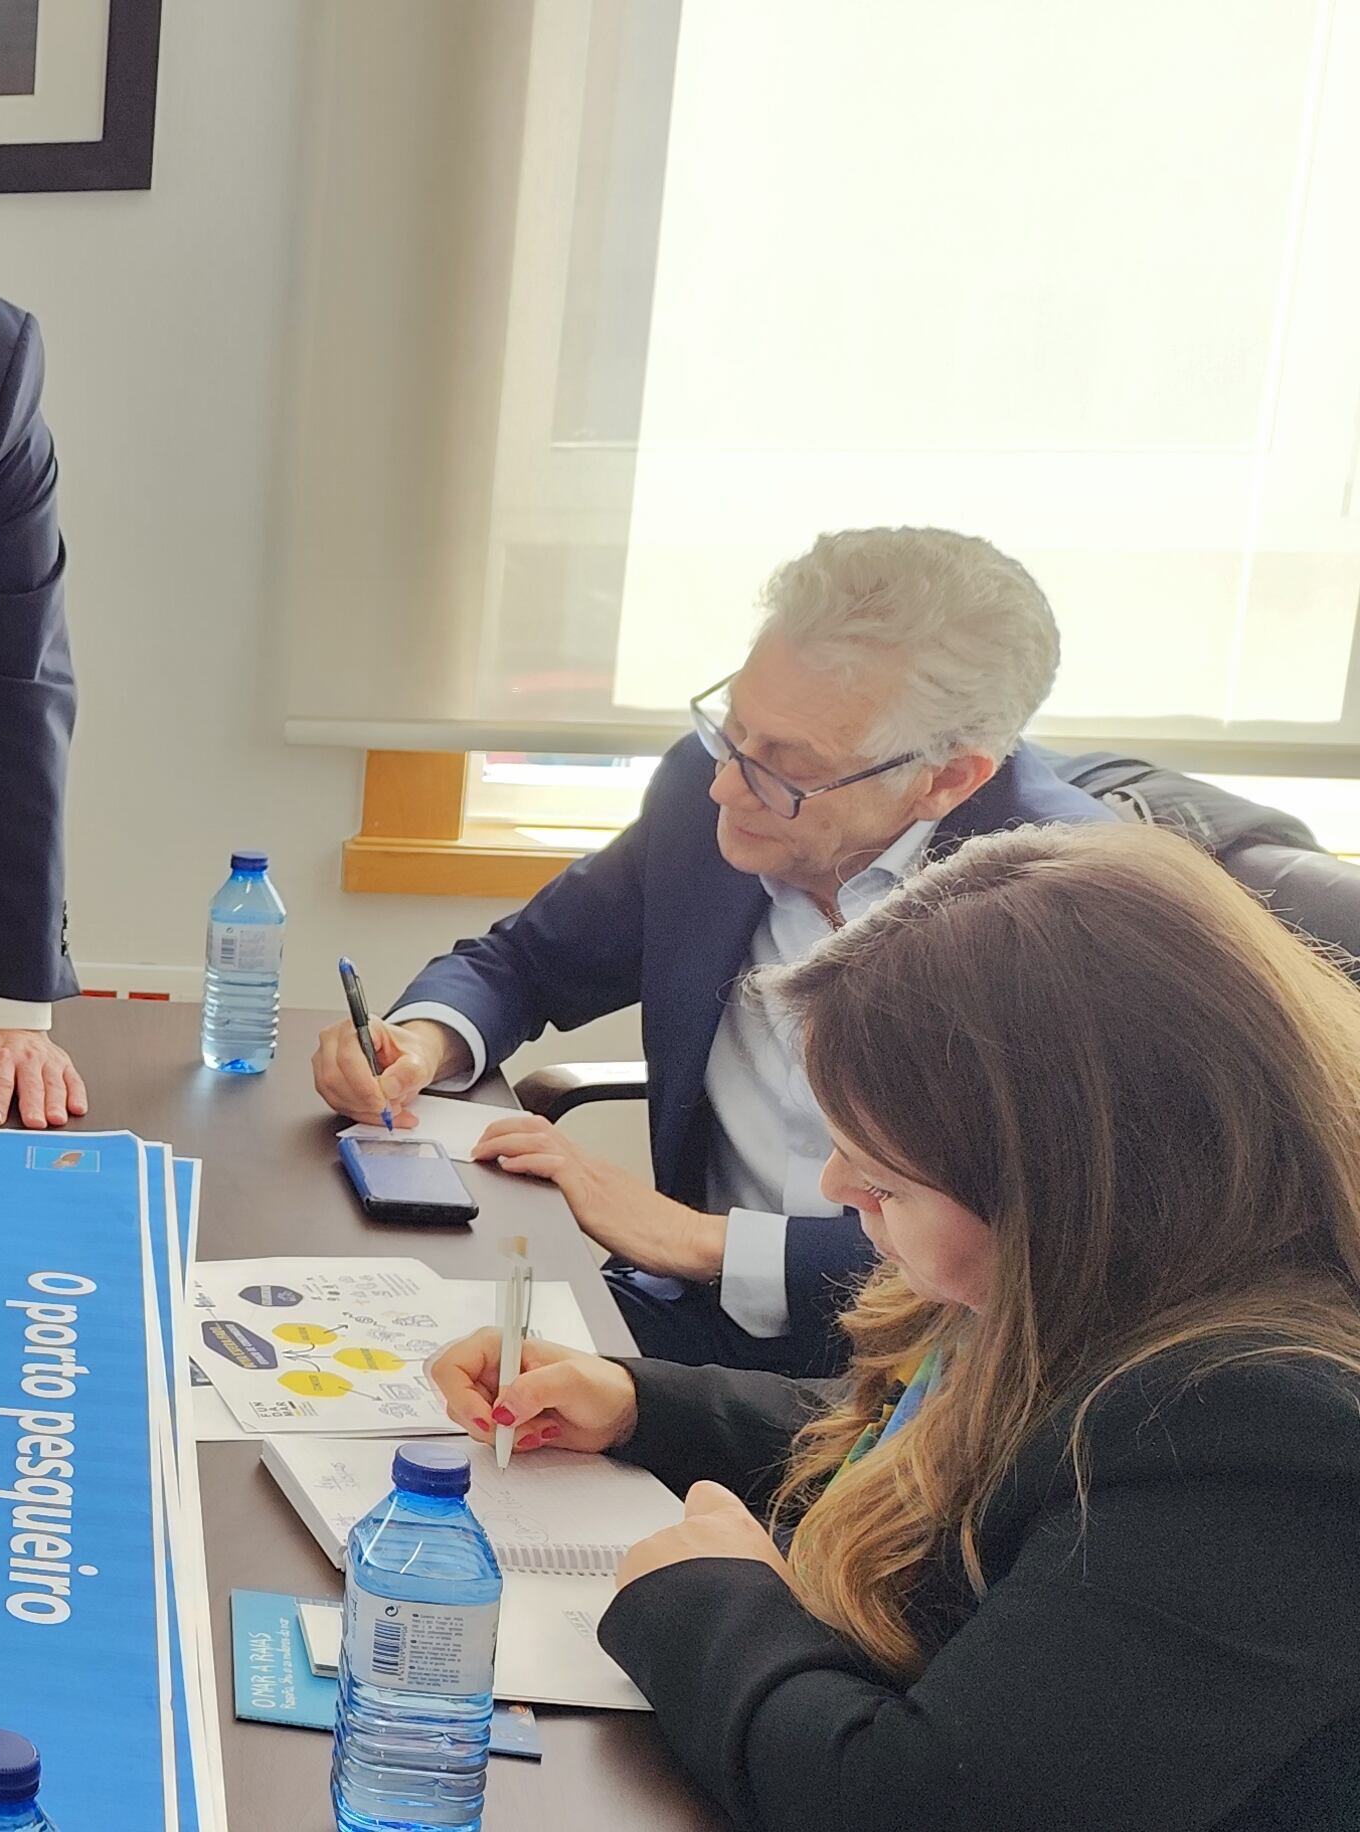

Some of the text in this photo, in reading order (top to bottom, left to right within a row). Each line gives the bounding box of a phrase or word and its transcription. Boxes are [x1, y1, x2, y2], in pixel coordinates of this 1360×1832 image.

[26, 1271, 97, 1296] O
[5, 1299, 90, 1399] porto
[250, 1674, 279, 1698] MAR
